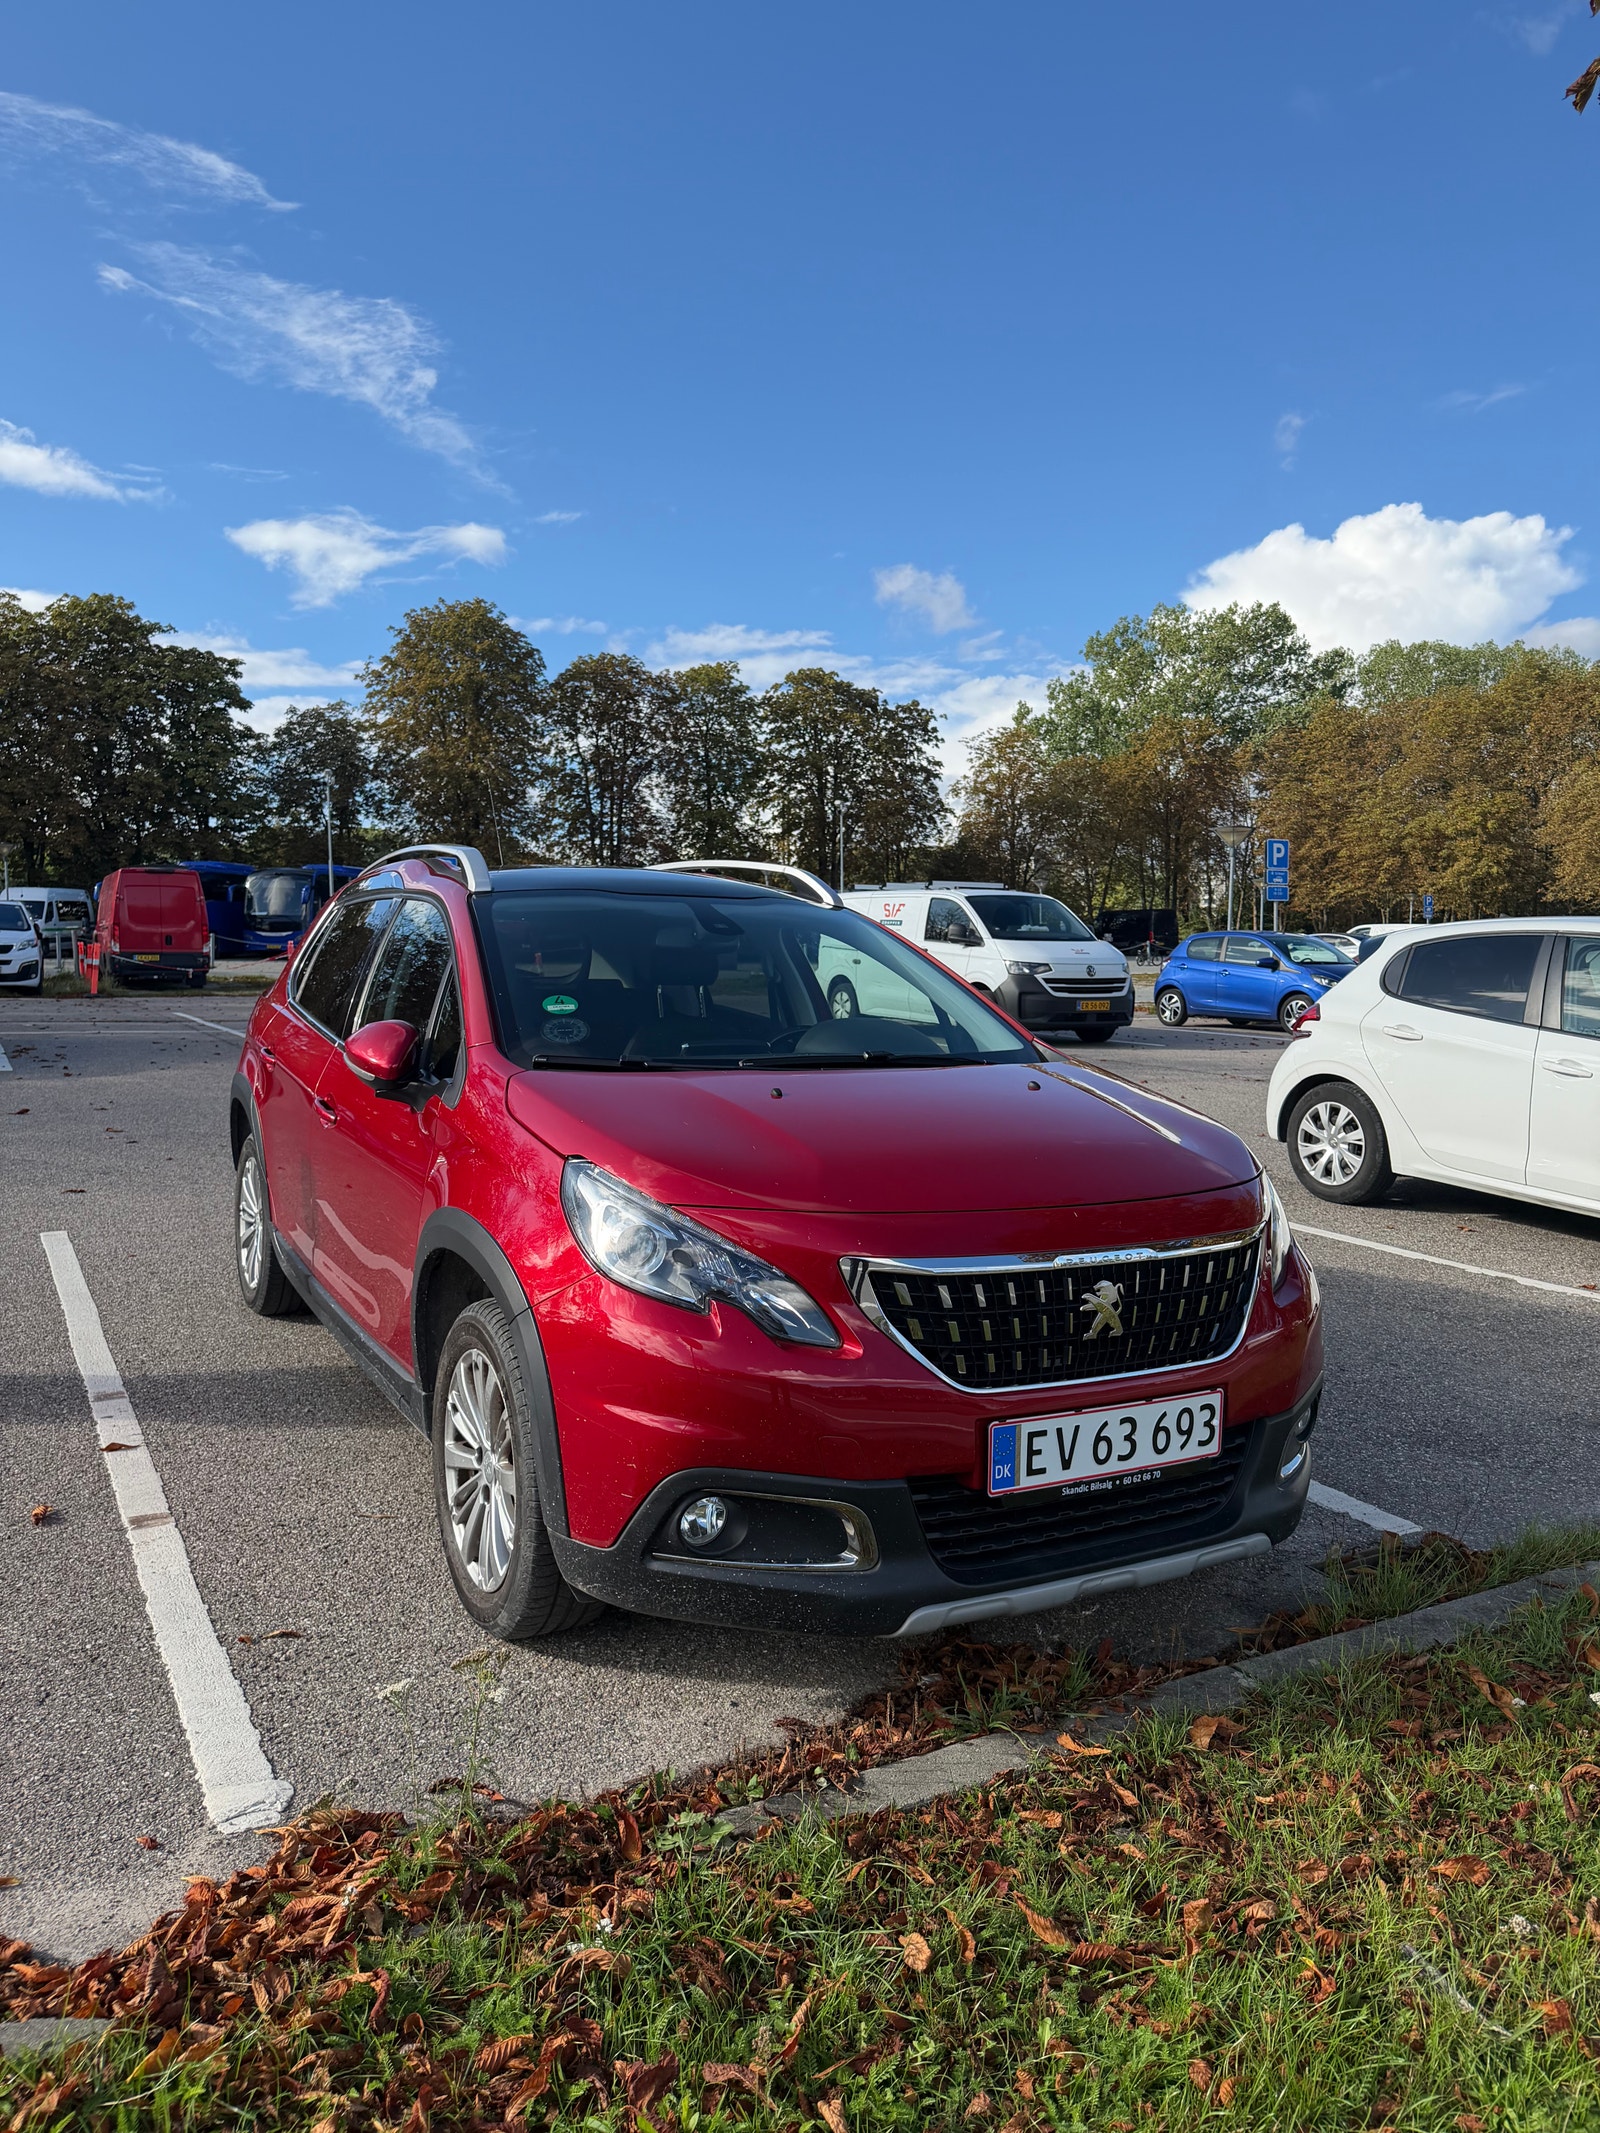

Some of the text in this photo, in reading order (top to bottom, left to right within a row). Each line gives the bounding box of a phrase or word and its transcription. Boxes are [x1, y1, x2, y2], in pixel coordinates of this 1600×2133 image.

[1272, 842, 1286, 866] P
[1426, 896, 1432, 906] P
[883, 903, 906, 918] SIF
[1081, 1002, 1089, 1010] ER
[1098, 1002, 1109, 1010] 092
[1065, 1251, 1144, 1267] PEUGEOT
[1026, 1403, 1217, 1477] EV 63 693
[995, 1464, 1011, 1480] DK
[1061, 1470, 1161, 1496] Skandic Bilsalg 60 62 66 70
